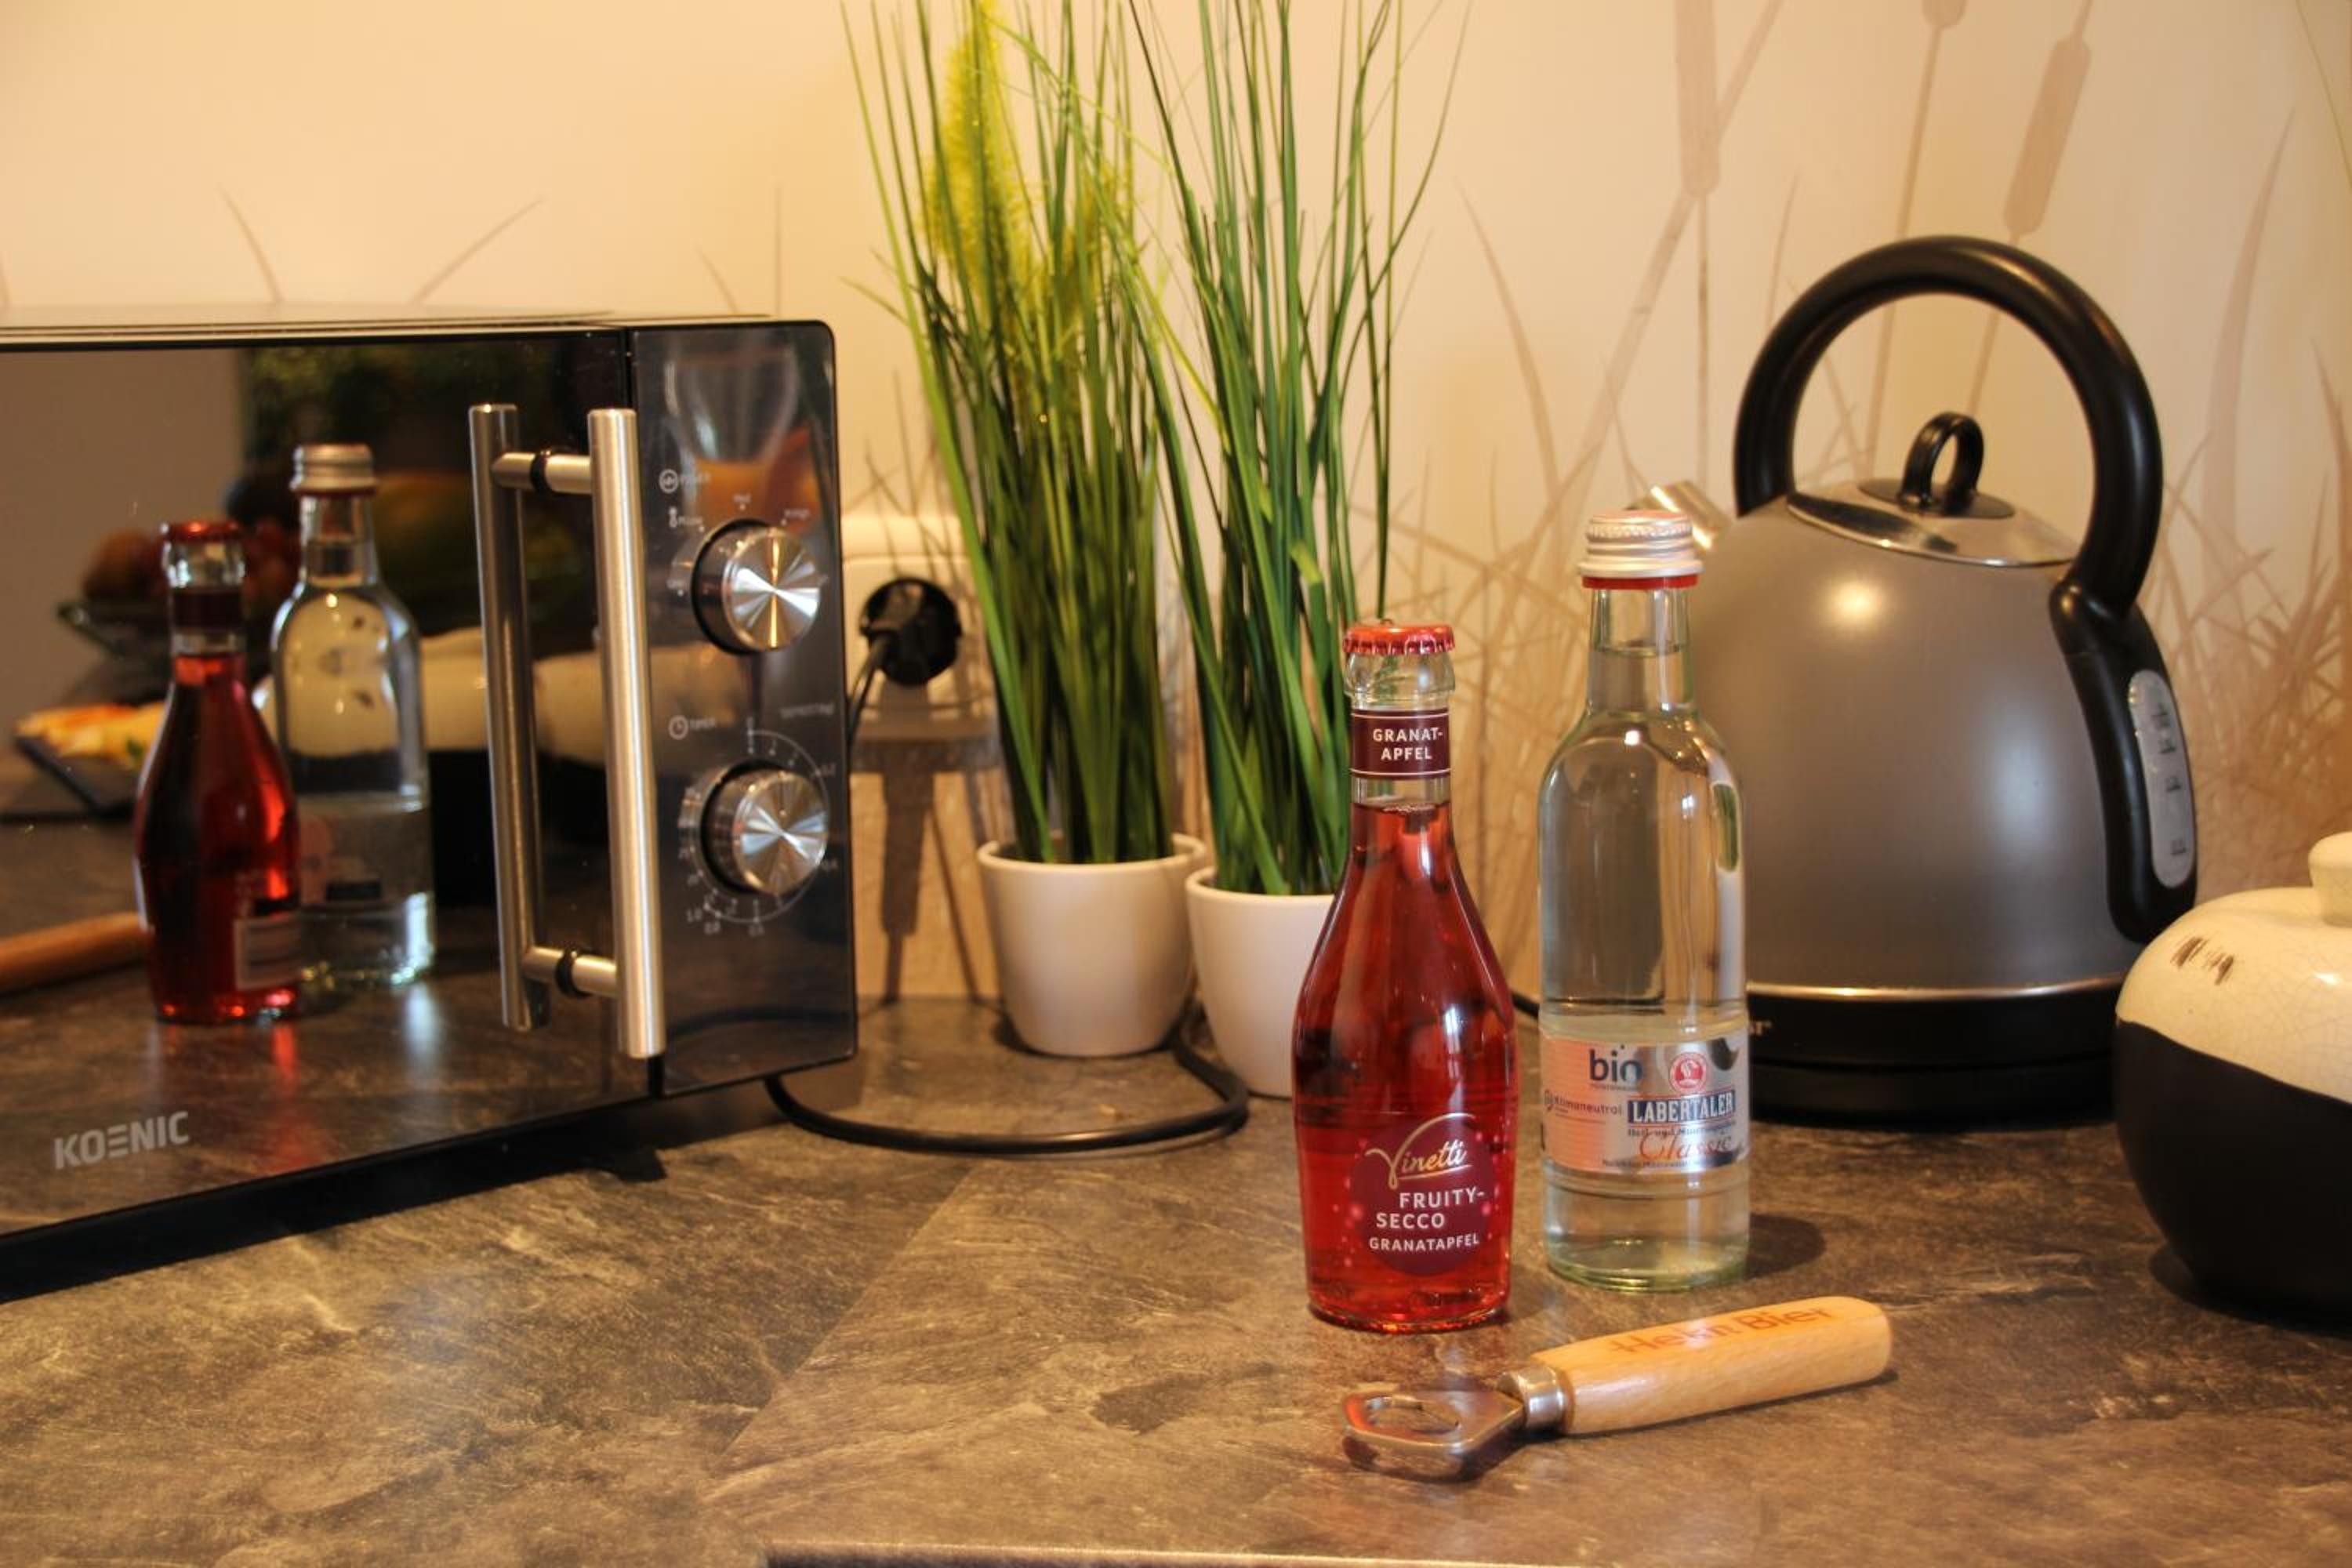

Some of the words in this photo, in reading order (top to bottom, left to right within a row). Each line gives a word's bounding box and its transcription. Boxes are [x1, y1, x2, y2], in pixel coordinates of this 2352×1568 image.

[1373, 727, 1443, 742] GRANAT-
[1381, 746, 1432, 761] APFEL
[1588, 1047, 1643, 1082] bio
[1632, 1091, 1733, 1123] LABERTALER
[54, 1110, 190, 1170] KOENIC
[1364, 1112, 1476, 1190] Vinetti
[1399, 1186, 1486, 1209] FRUITY-
[1376, 1212, 1445, 1229] SECCO
[1369, 1233, 1480, 1252] GRANATAPFEL
[1734, 1307, 1833, 1332] Bier
